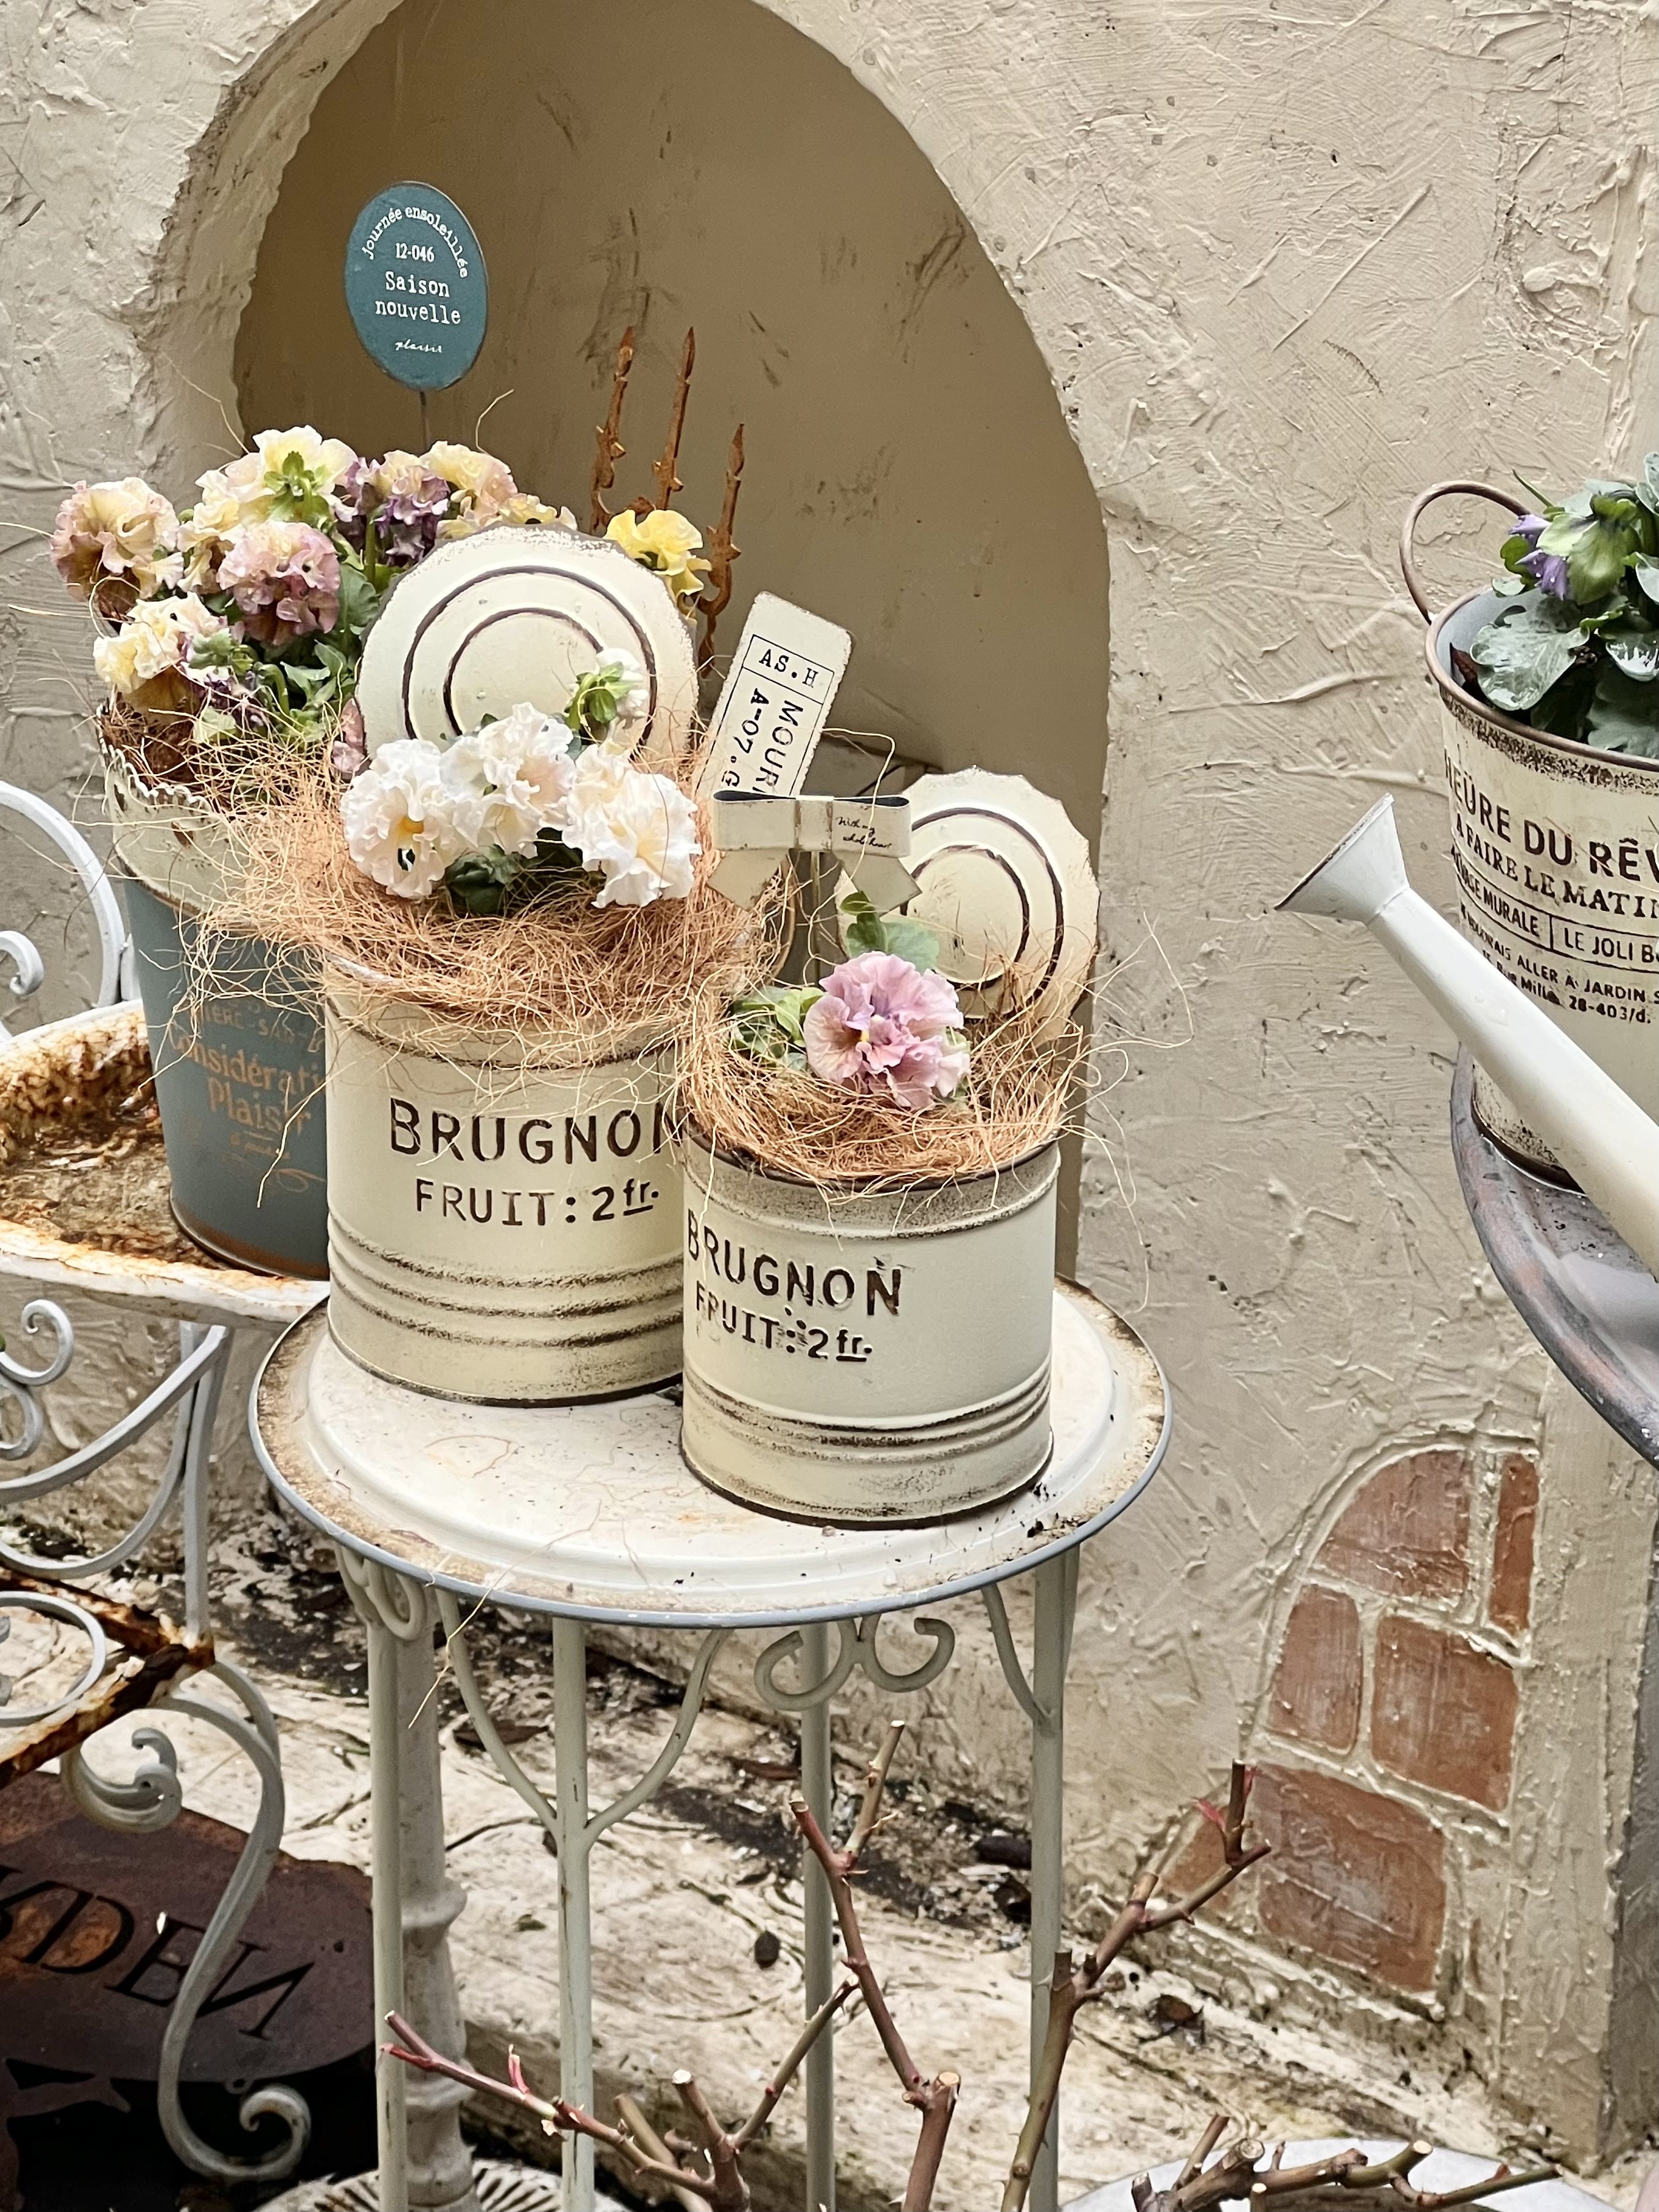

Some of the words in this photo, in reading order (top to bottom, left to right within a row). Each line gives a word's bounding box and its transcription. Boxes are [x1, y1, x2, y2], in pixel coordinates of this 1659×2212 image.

[362, 207, 403, 260] journée
[405, 207, 468, 278] ensoleillée
[396, 243, 435, 262] 12-046
[385, 271, 450, 297] Saison
[375, 300, 461, 324] nouvelle
[1466, 824, 1518, 881] FAIRE
[1524, 865, 1556, 899] LE
[1524, 819, 1572, 866] DU
[1483, 886, 1540, 937] MURALE
[1564, 928, 1585, 951] LE
[1592, 937, 1633, 960] JOLI
[1517, 955, 1558, 984] ALLER
[1584, 979, 1646, 1003] JARDIN
[688, 1208, 902, 1316] BRUGNON
